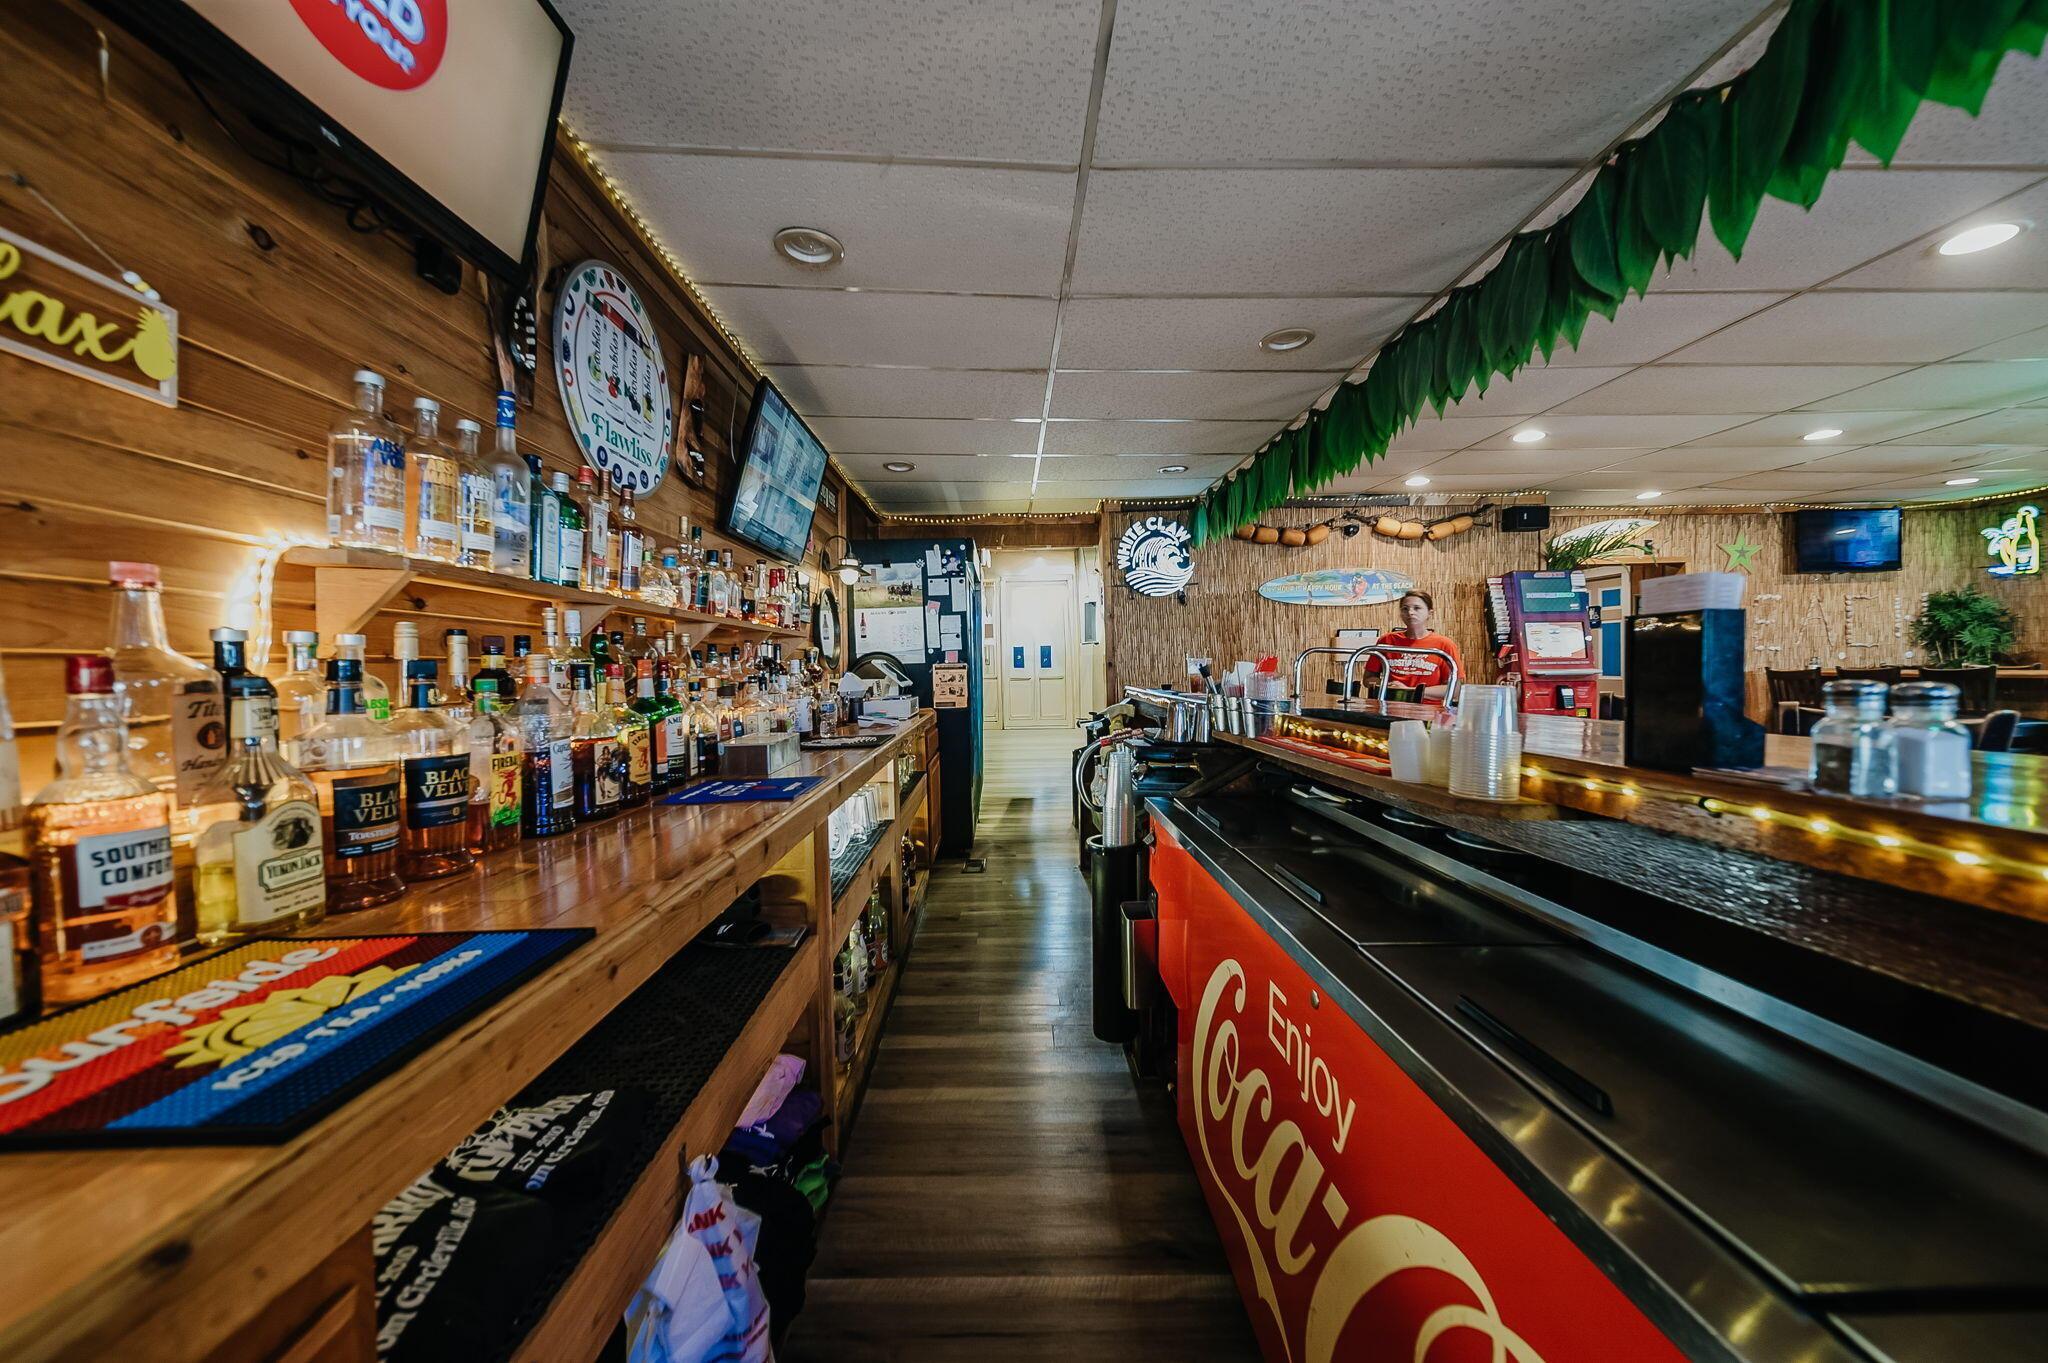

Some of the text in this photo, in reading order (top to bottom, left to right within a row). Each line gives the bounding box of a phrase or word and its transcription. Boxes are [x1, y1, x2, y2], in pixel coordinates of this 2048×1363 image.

[591, 412, 652, 467] Flawliss
[1117, 516, 1192, 570] WHITE CLAW
[1303, 584, 1323, 592] HAPPY
[1393, 582, 1414, 590] BEACH
[266, 853, 320, 880] YUKON JACK
[212, 1042, 309, 1091] ICED
[305, 1003, 381, 1042] TEA
[395, 948, 484, 994] VODKA
[1267, 979, 1358, 1154] Enjoy
